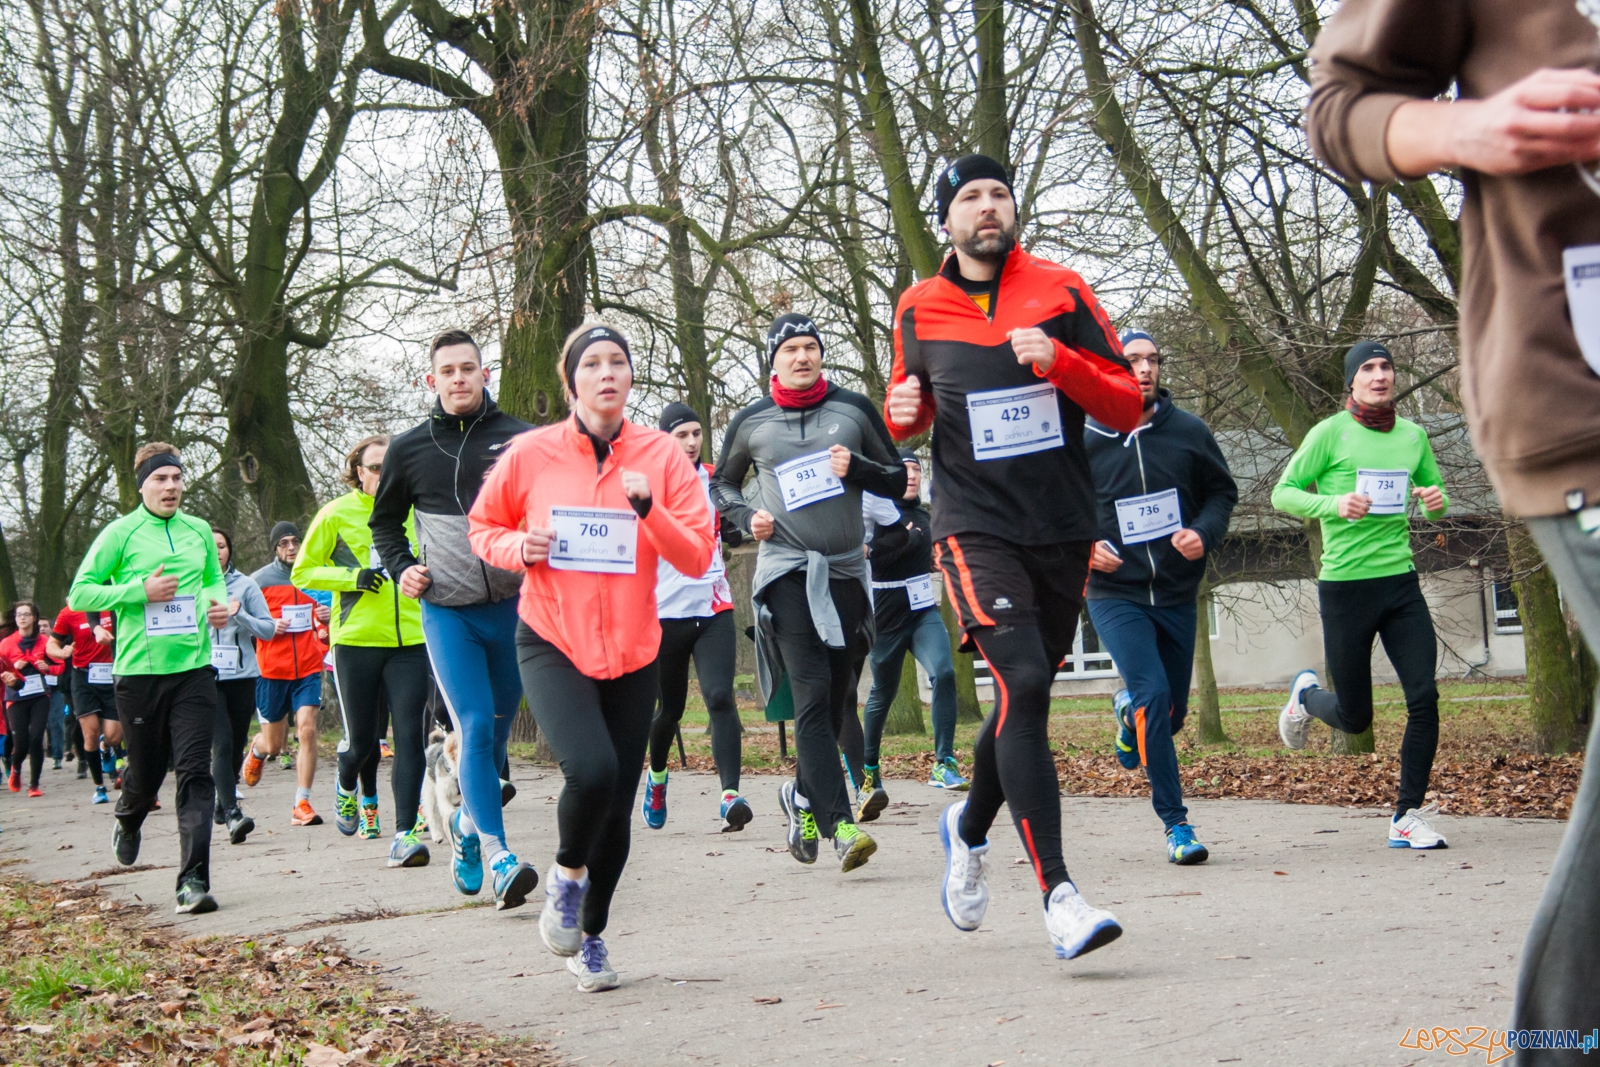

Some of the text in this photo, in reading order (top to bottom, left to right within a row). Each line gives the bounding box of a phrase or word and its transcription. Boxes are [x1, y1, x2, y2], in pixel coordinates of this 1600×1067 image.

[1001, 405, 1030, 422] 429
[1005, 426, 1033, 441] parkrun
[796, 468, 817, 482] 931
[1378, 480, 1394, 490] 734
[1138, 504, 1160, 517] 736
[580, 523, 608, 537] 760
[580, 542, 608, 554] parkrun
[164, 604, 182, 613] 486
